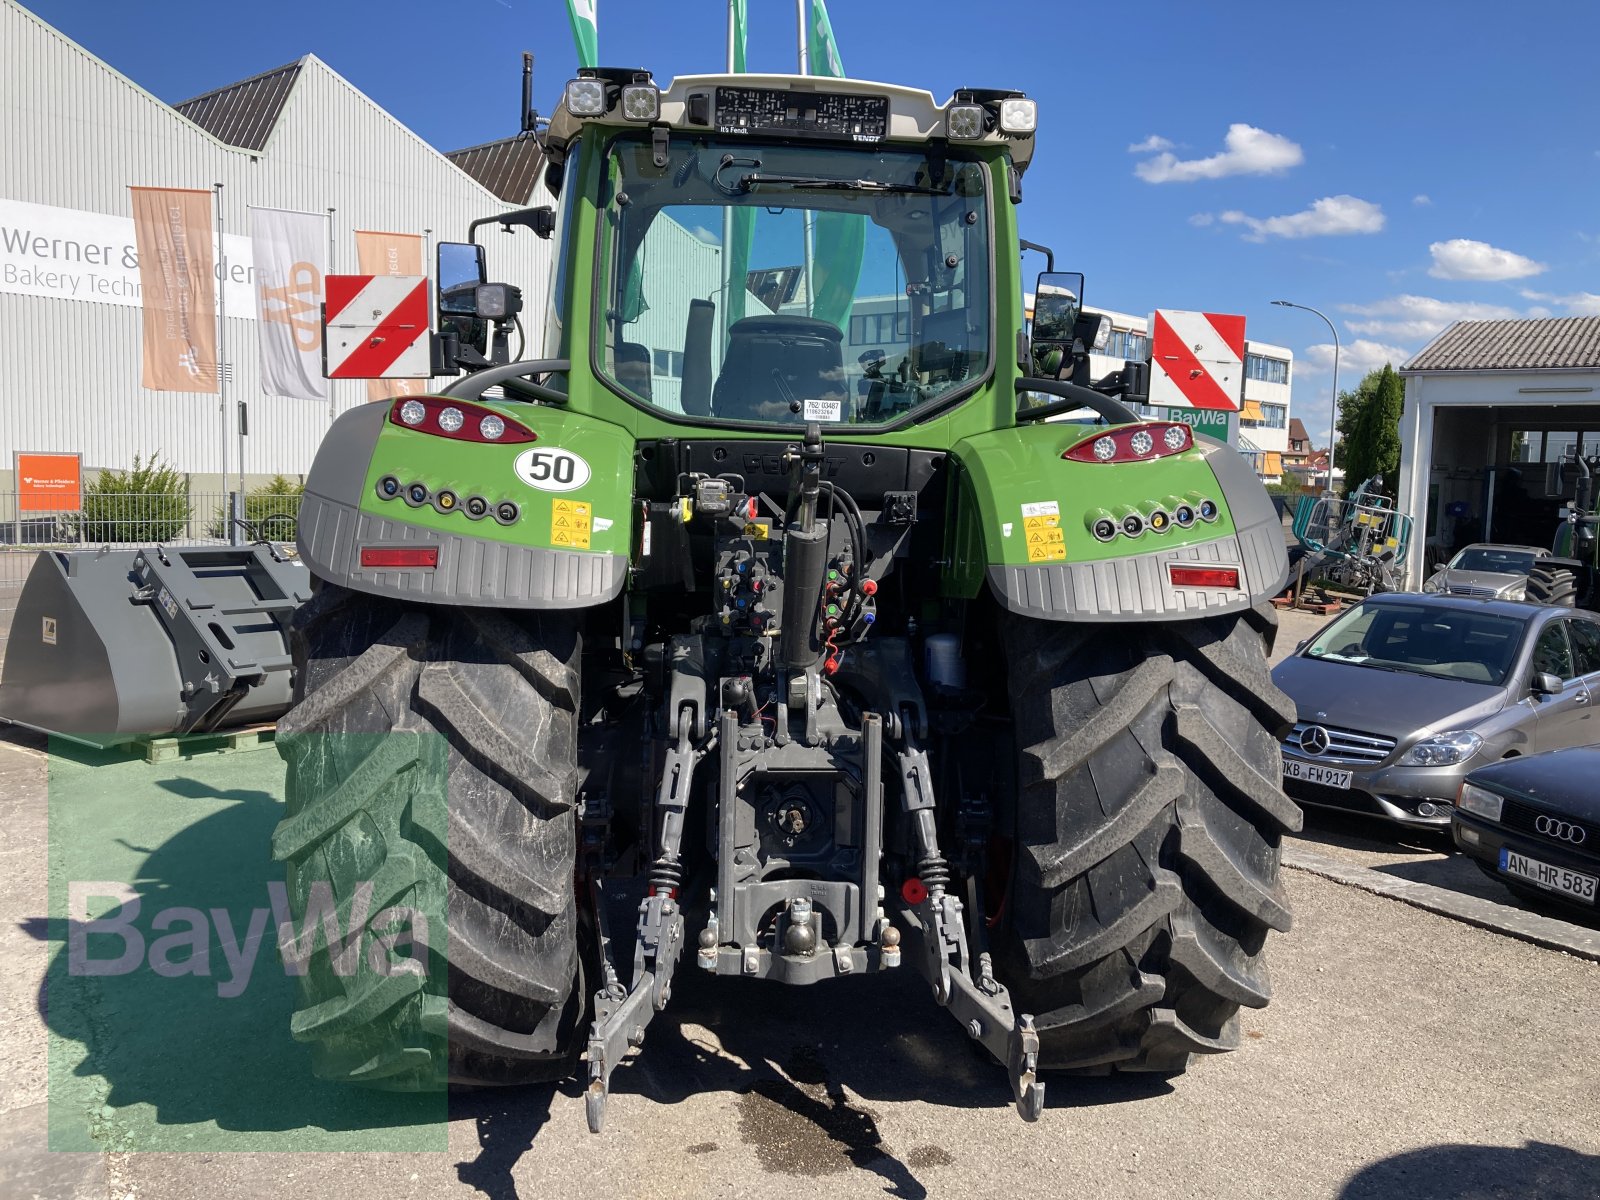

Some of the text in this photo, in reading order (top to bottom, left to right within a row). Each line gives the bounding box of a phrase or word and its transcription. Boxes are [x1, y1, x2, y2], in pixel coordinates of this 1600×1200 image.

[852, 134, 881, 143] FENDT
[2, 226, 143, 269] Werner &
[4, 264, 80, 296] Bakery
[1170, 409, 1226, 427] BayWa
[529, 452, 575, 483] 50
[1308, 767, 1324, 781] FW
[1326, 770, 1348, 786] 917
[1509, 855, 1528, 876] AN
[1538, 864, 1558, 886] HR
[1562, 873, 1594, 897] 583
